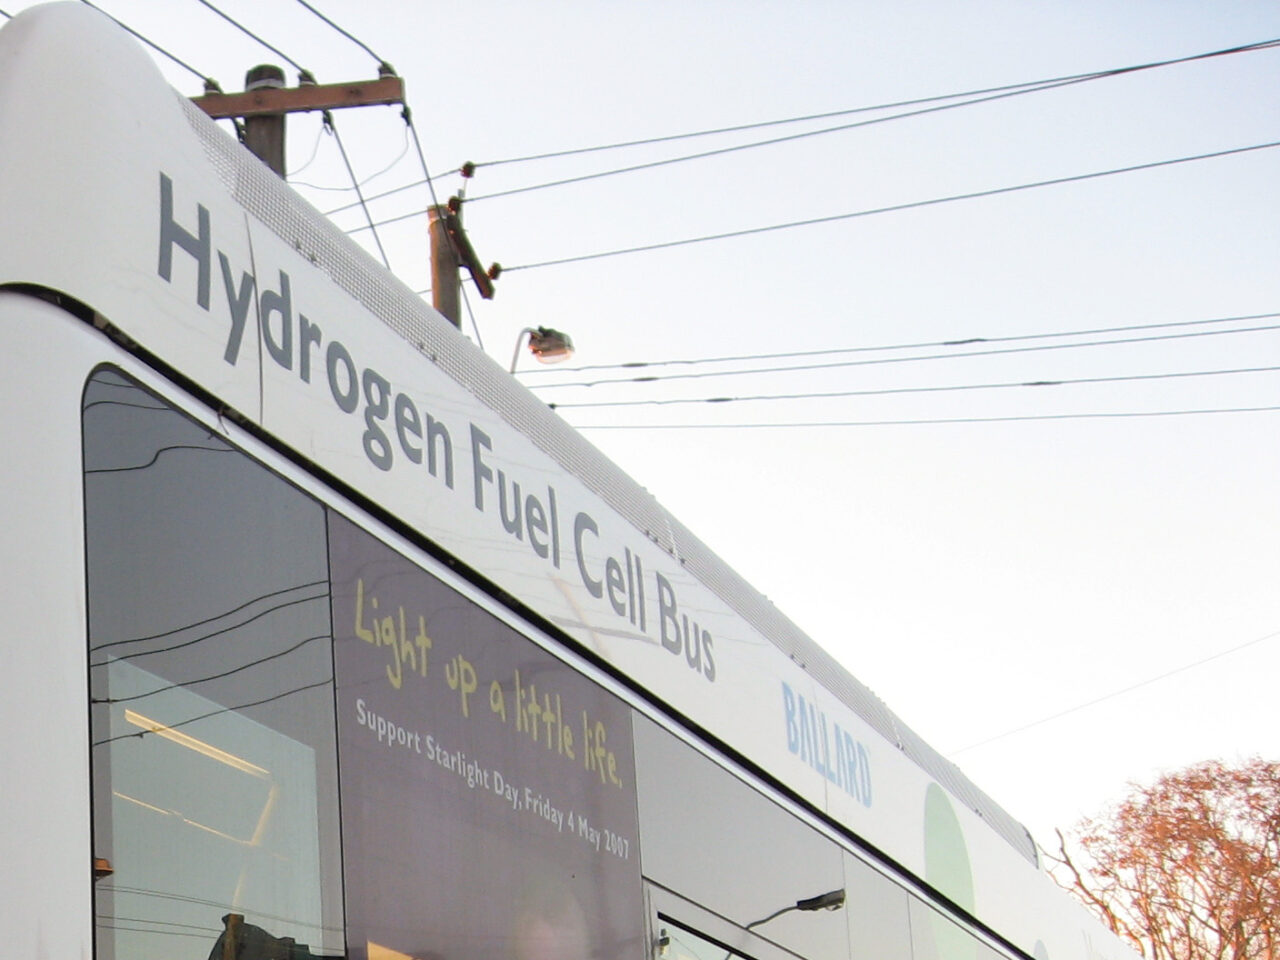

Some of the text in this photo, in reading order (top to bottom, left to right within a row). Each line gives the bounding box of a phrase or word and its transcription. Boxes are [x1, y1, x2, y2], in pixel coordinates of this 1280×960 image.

[157, 170, 718, 684] Hydrogen Fuel Cell Bus
[355, 578, 624, 790] Light up a little life.
[781, 680, 873, 809] BALLARD
[356, 698, 630, 861] Support Starlight Day, Friday 4 May 2007
